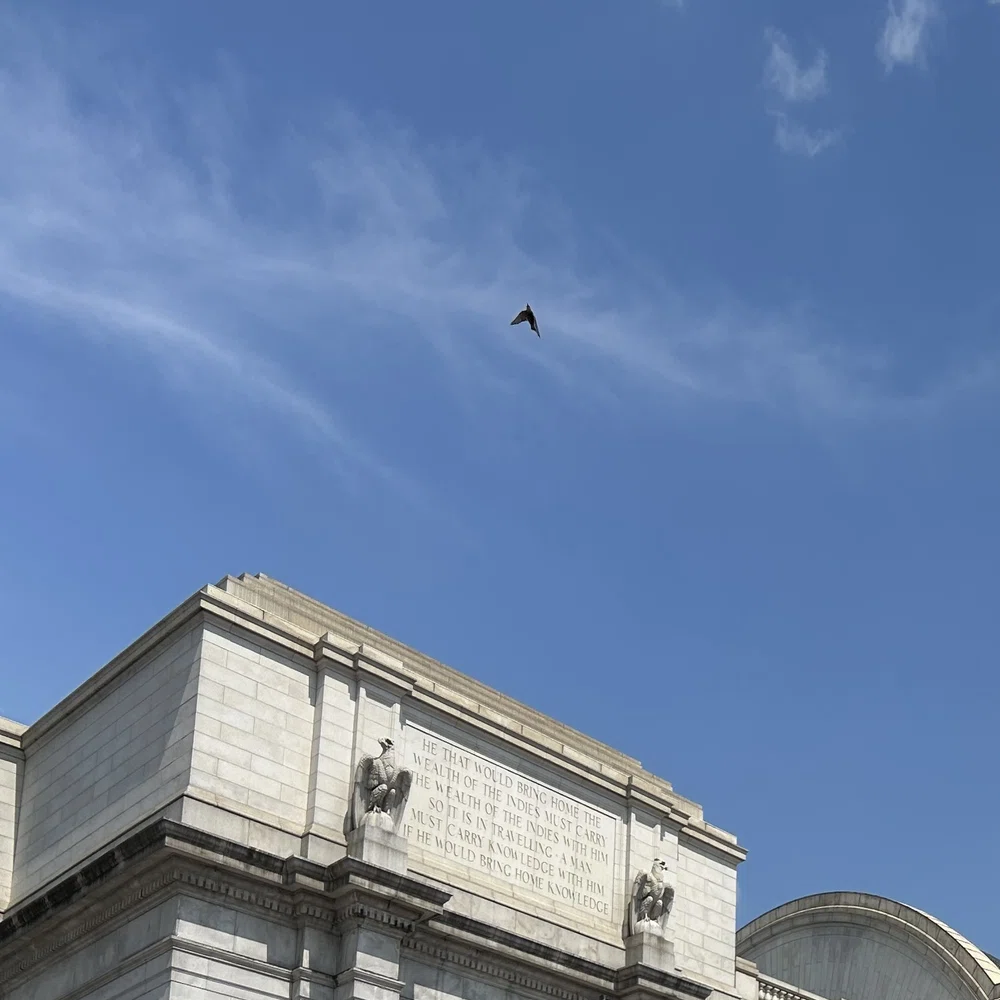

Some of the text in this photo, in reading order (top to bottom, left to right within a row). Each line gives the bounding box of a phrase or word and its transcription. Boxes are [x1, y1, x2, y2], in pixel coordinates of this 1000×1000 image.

[411, 770, 608, 865] THE WEALTH OF THE INDIES WITH HIM
[413, 753, 608, 847] WEALTH OF THE INDIES MUST CARRY
[423, 739, 601, 828] HE THAT WOULD BRING HOME THE
[403, 824, 609, 915] IF HE WOULD BRING HOME KNOWLEDGE
[411, 808, 604, 896] MUST CARRY KNOWLEDGE WITH HIM
[429, 797, 592, 874] SO IT IS IN TRAVELLING A MAN
